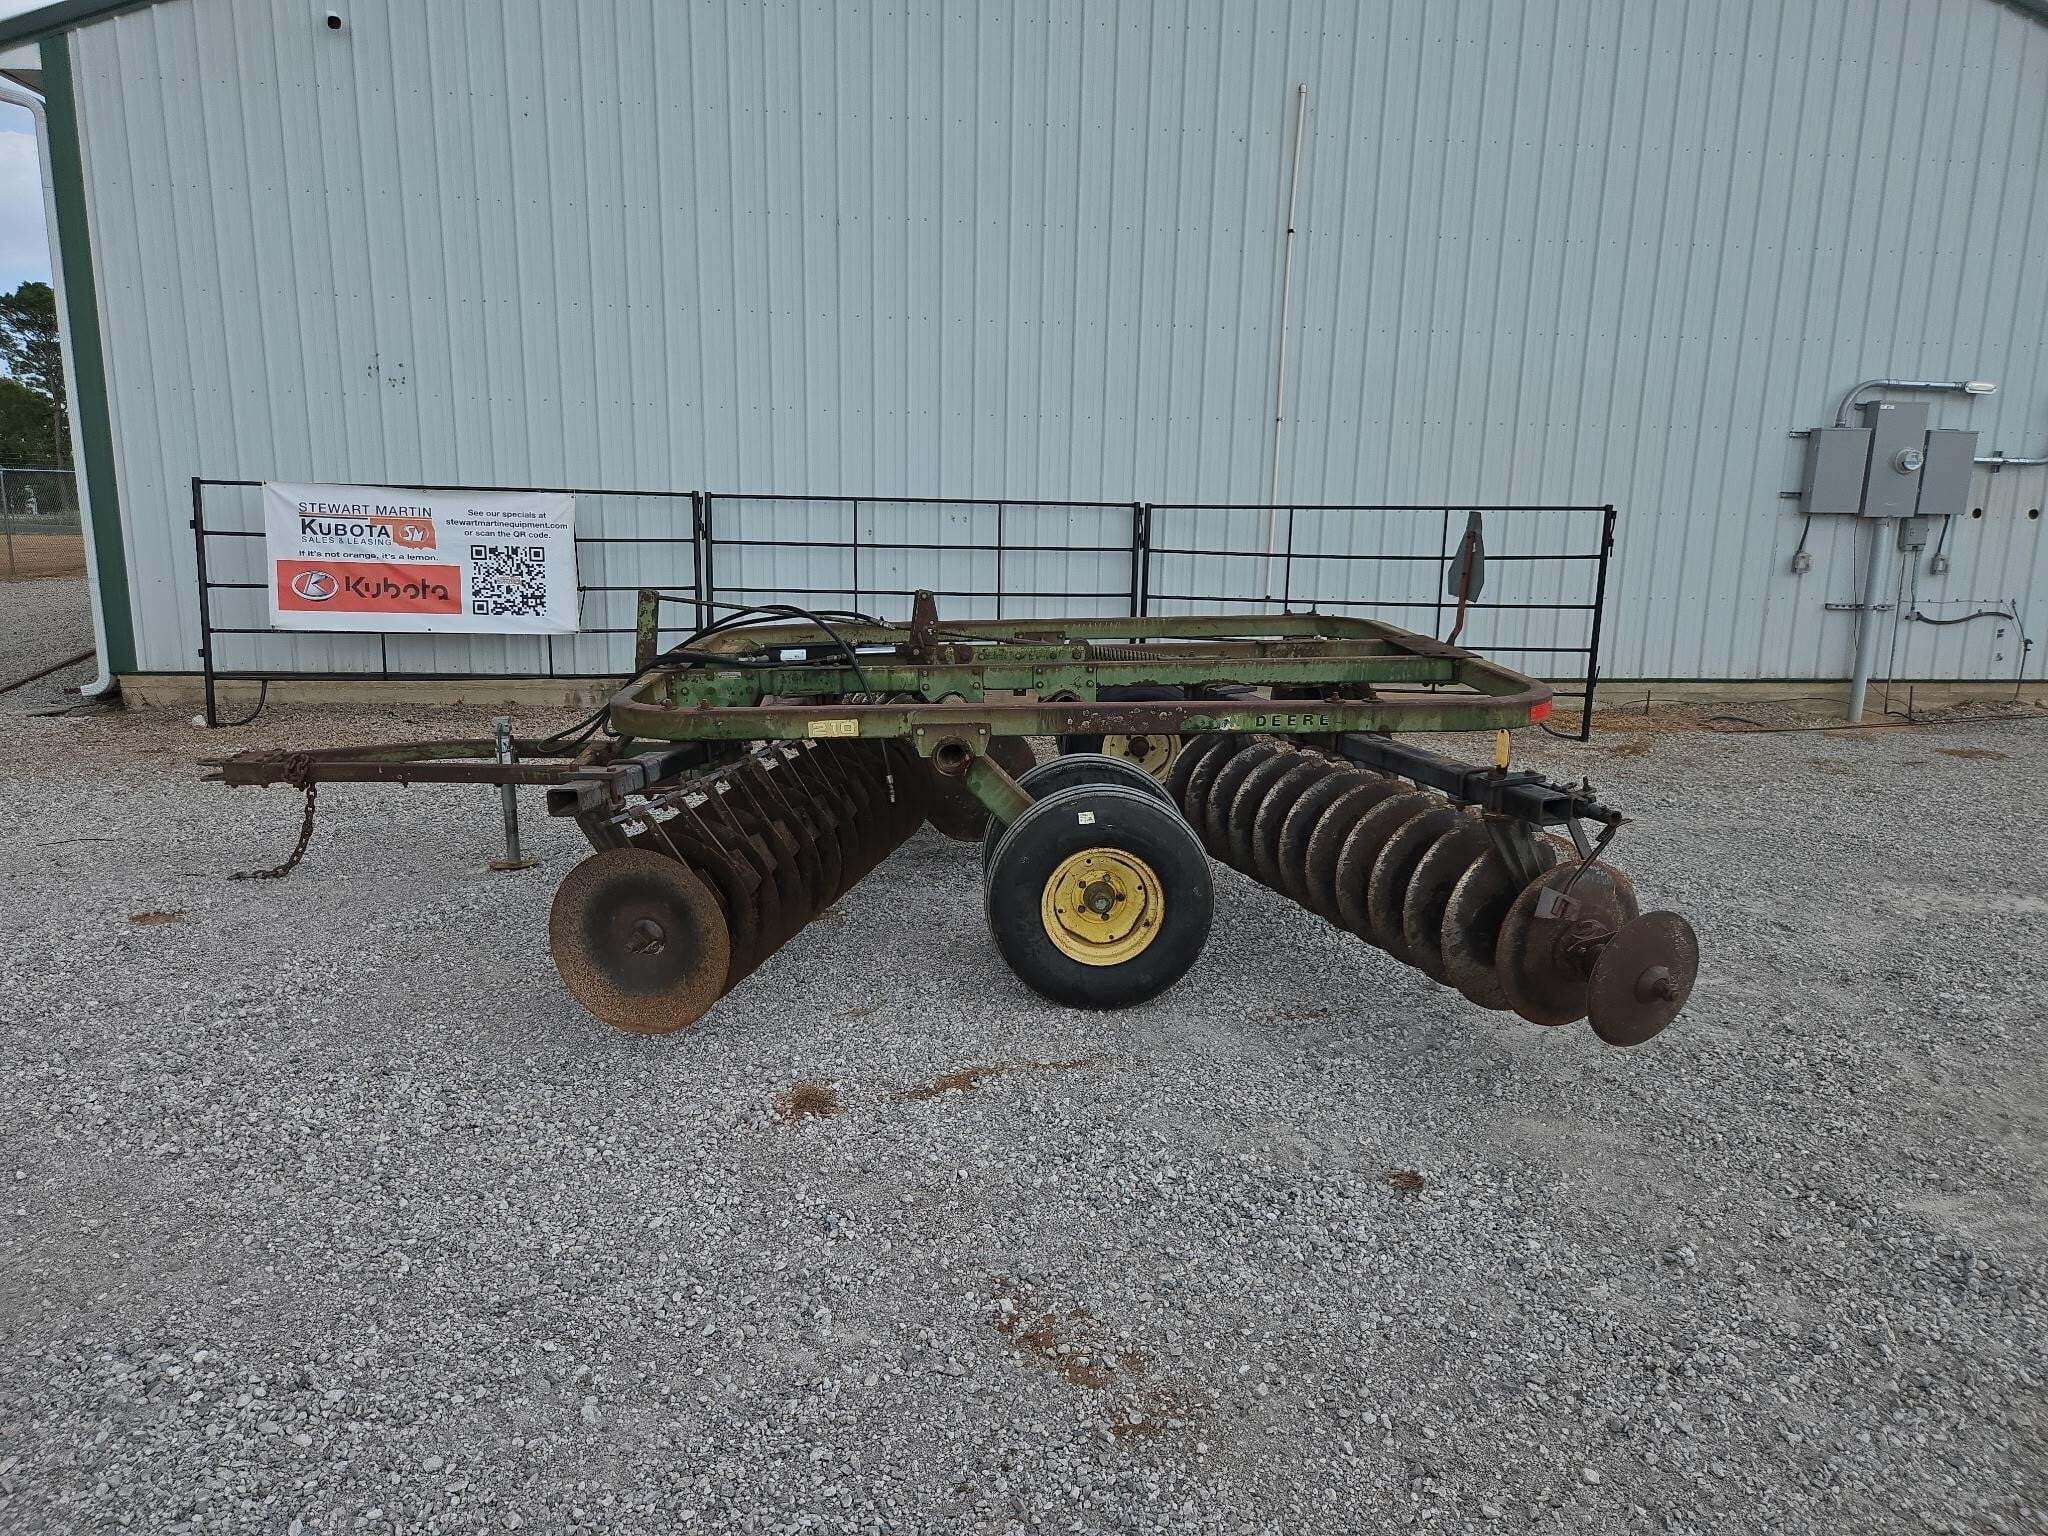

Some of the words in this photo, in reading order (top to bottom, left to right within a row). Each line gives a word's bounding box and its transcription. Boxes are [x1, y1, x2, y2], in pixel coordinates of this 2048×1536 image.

[298, 502, 370, 514] STEWART
[375, 505, 432, 517] MARTIN
[467, 509, 484, 517] See
[502, 511, 537, 519] specials
[300, 518, 391, 539] KUBOTA
[445, 518, 568, 530] stewartmartinequipment.com
[301, 536, 335, 544] SALES
[338, 537, 345, 545] &
[347, 538, 392, 546] LEASING
[475, 530, 496, 538] scan
[497, 530, 511, 538] the
[513, 530, 526, 539] QR
[528, 532, 551, 540] code.
[307, 550, 321, 558] it's
[324, 550, 341, 559] not
[343, 551, 380, 561] orange,
[382, 553, 396, 561] it's
[407, 553, 440, 562] lemon.
[345, 576, 449, 600] Kubota
[1255, 714, 1328, 727] DEERE
